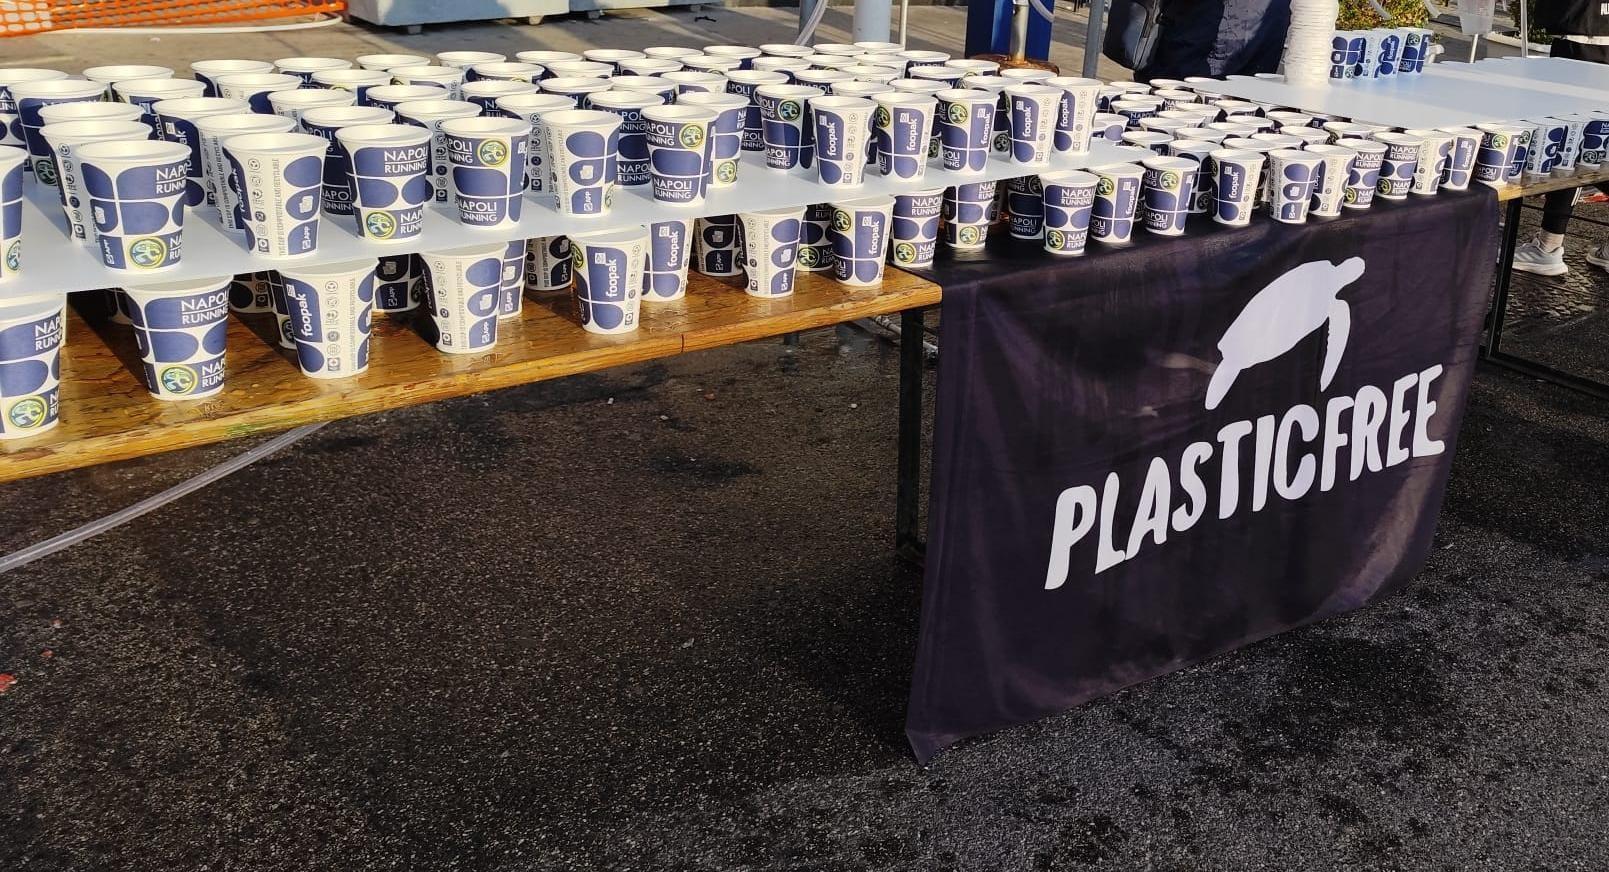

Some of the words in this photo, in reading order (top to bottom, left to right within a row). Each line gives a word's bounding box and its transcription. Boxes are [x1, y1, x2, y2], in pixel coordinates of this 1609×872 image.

[980, 112, 992, 145] foopak
[1022, 105, 1033, 138] foopak
[1060, 98, 1071, 127] foopak
[827, 122, 838, 157] foopak
[906, 117, 918, 152] foopak
[1229, 171, 1240, 199] foopak
[667, 230, 680, 267] foopak
[869, 220, 880, 256] foopak
[605, 258, 620, 298] foopak
[296, 293, 314, 337] foopak
